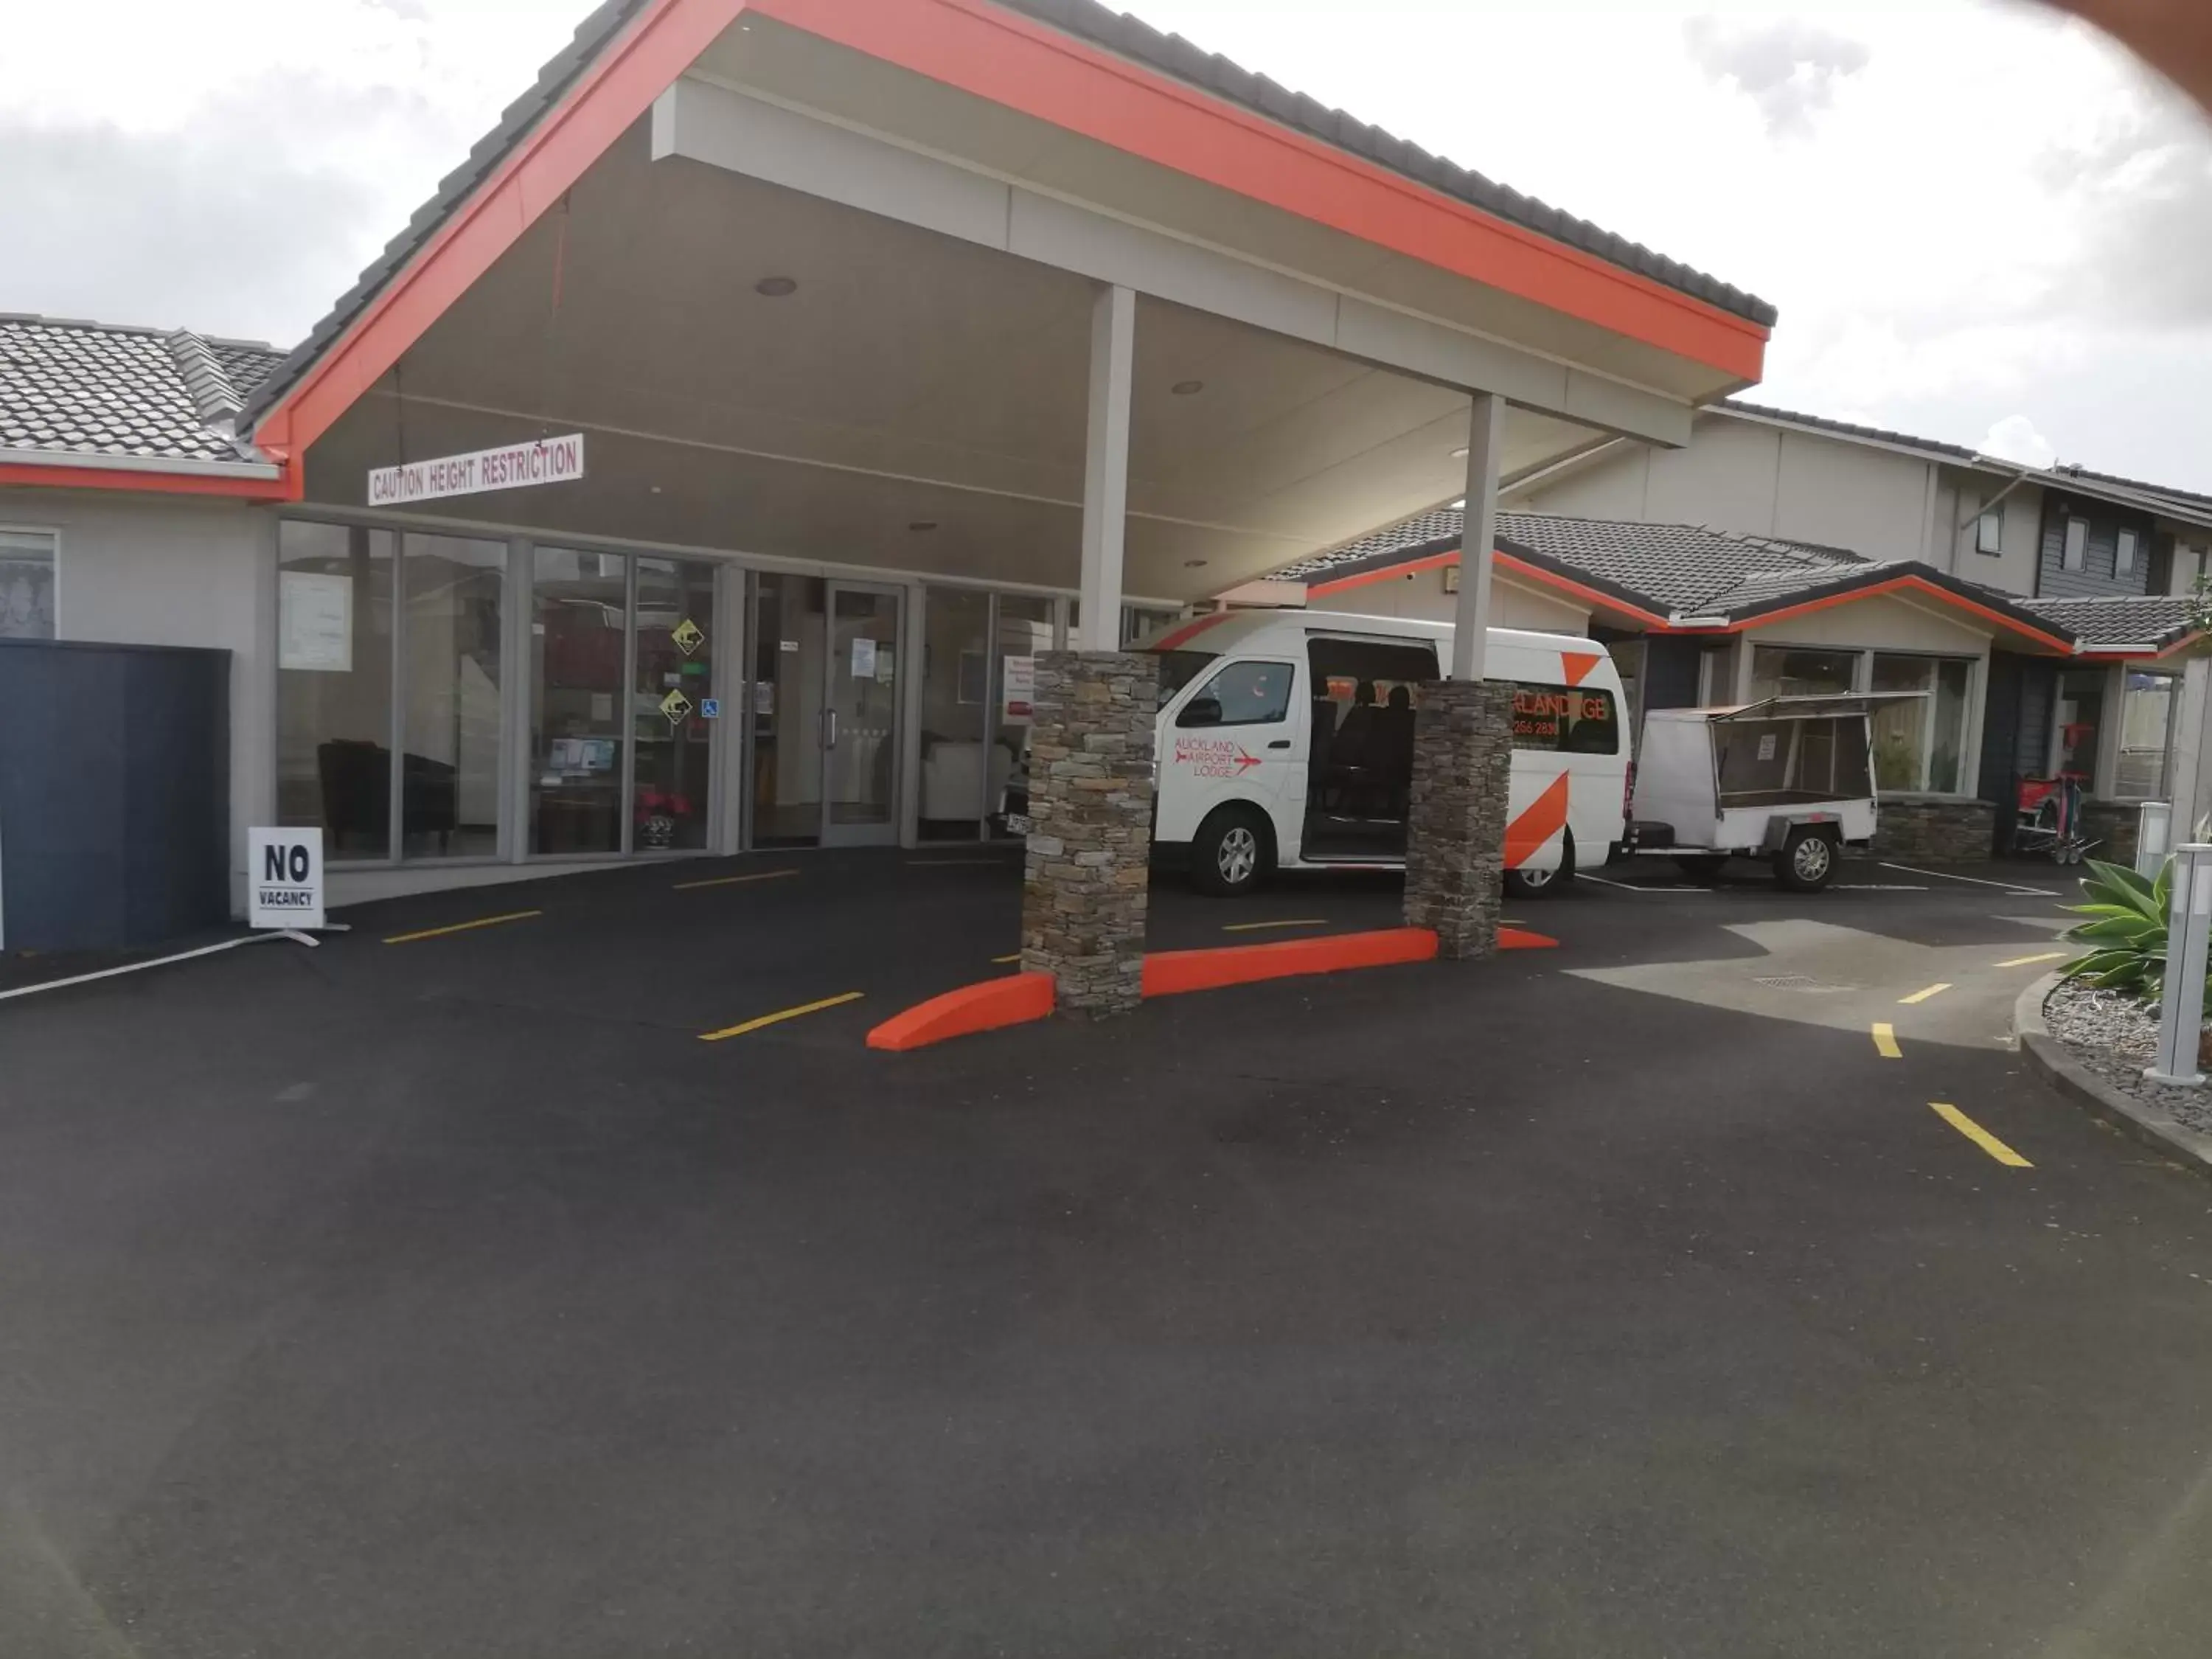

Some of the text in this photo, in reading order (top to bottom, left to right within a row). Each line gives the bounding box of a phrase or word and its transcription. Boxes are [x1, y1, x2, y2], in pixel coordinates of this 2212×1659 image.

[374, 441, 577, 499] CAUTION HEIGHT RESTRICTION
[1175, 737, 1235, 753] AUCKLAND
[1187, 751, 1234, 765] AIRPORT
[1194, 765, 1233, 778] LODGE
[265, 844, 309, 883] NO
[259, 891, 313, 905] VACANCY
